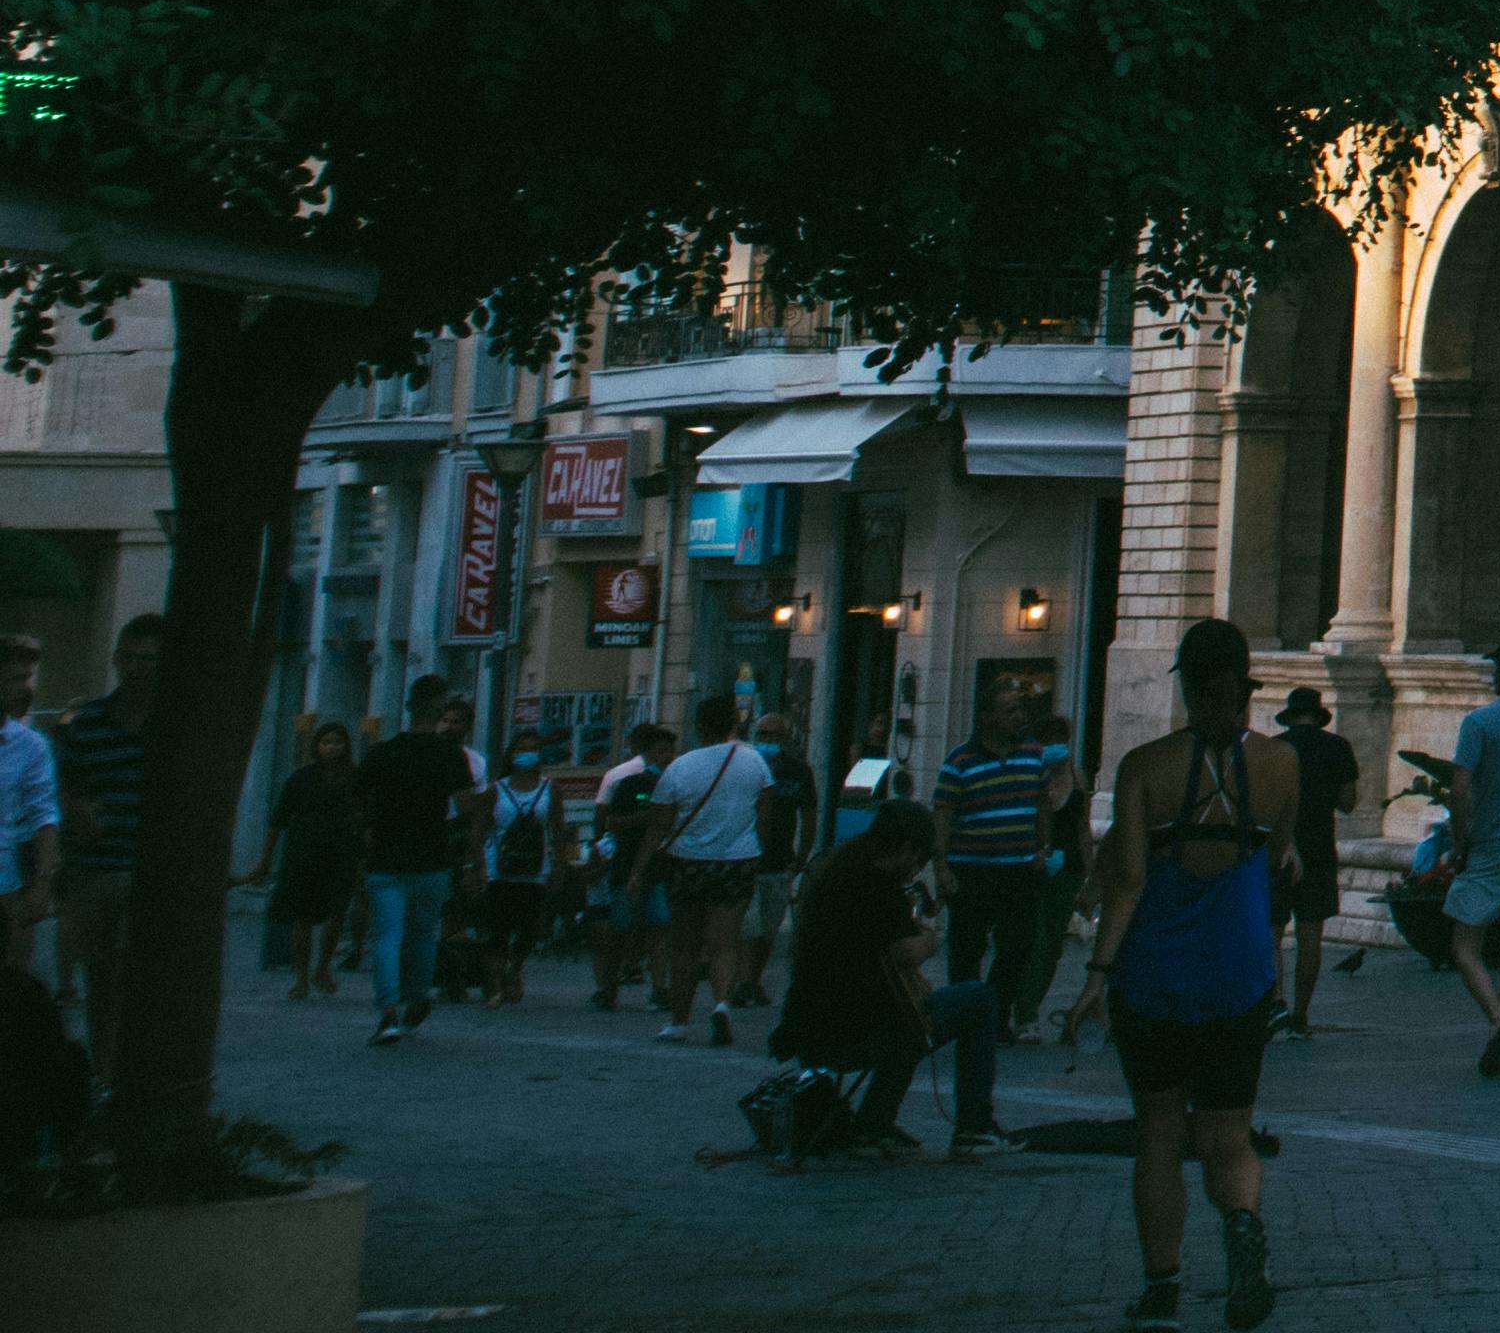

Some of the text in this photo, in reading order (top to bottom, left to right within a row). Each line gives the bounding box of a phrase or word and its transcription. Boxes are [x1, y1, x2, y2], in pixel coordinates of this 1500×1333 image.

[546, 445, 624, 517] CARAVEL
[464, 477, 498, 630] CARAVEL
[593, 620, 651, 633] MINOAN
[603, 634, 641, 646] LINES
